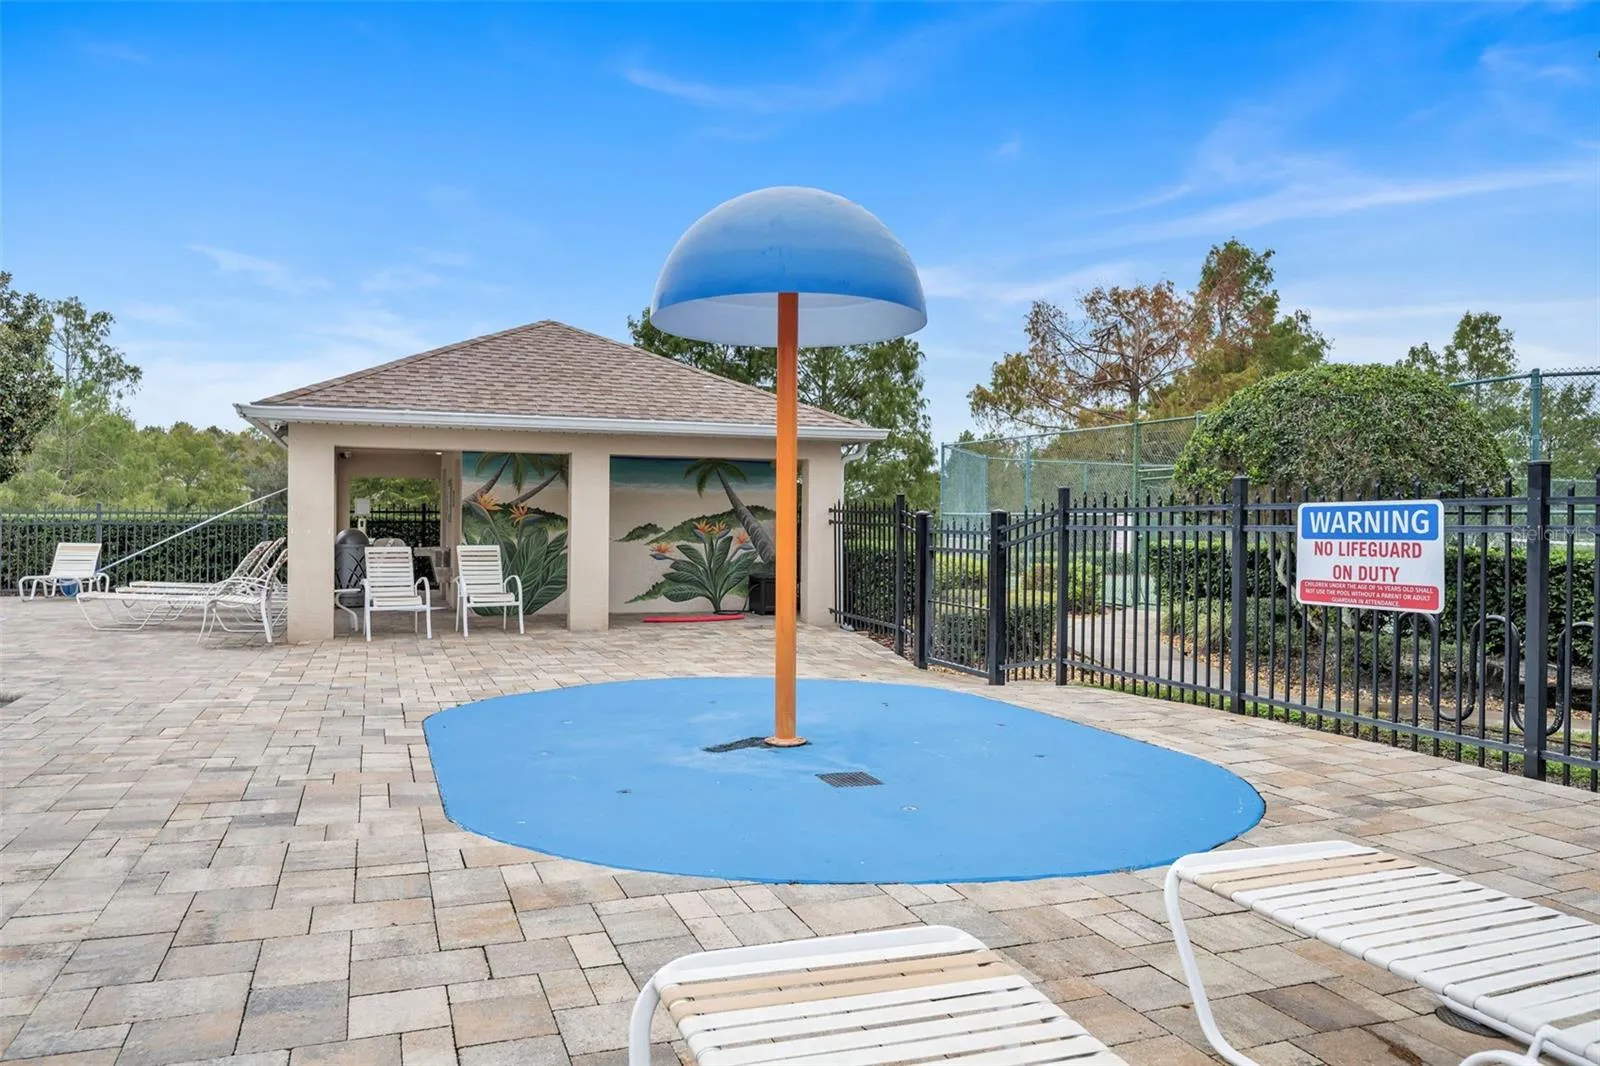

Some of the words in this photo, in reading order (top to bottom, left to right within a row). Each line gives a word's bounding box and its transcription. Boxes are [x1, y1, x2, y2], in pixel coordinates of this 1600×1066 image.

[1310, 510, 1429, 534] WARNING
[1314, 541, 1333, 556] NO
[1338, 541, 1422, 558] LIFEGUARD
[1333, 565, 1352, 580] ON
[1358, 566, 1400, 582] DUTY
[1331, 596, 1357, 604] GUARDIAN
[1350, 590, 1375, 598] WITHOUT
